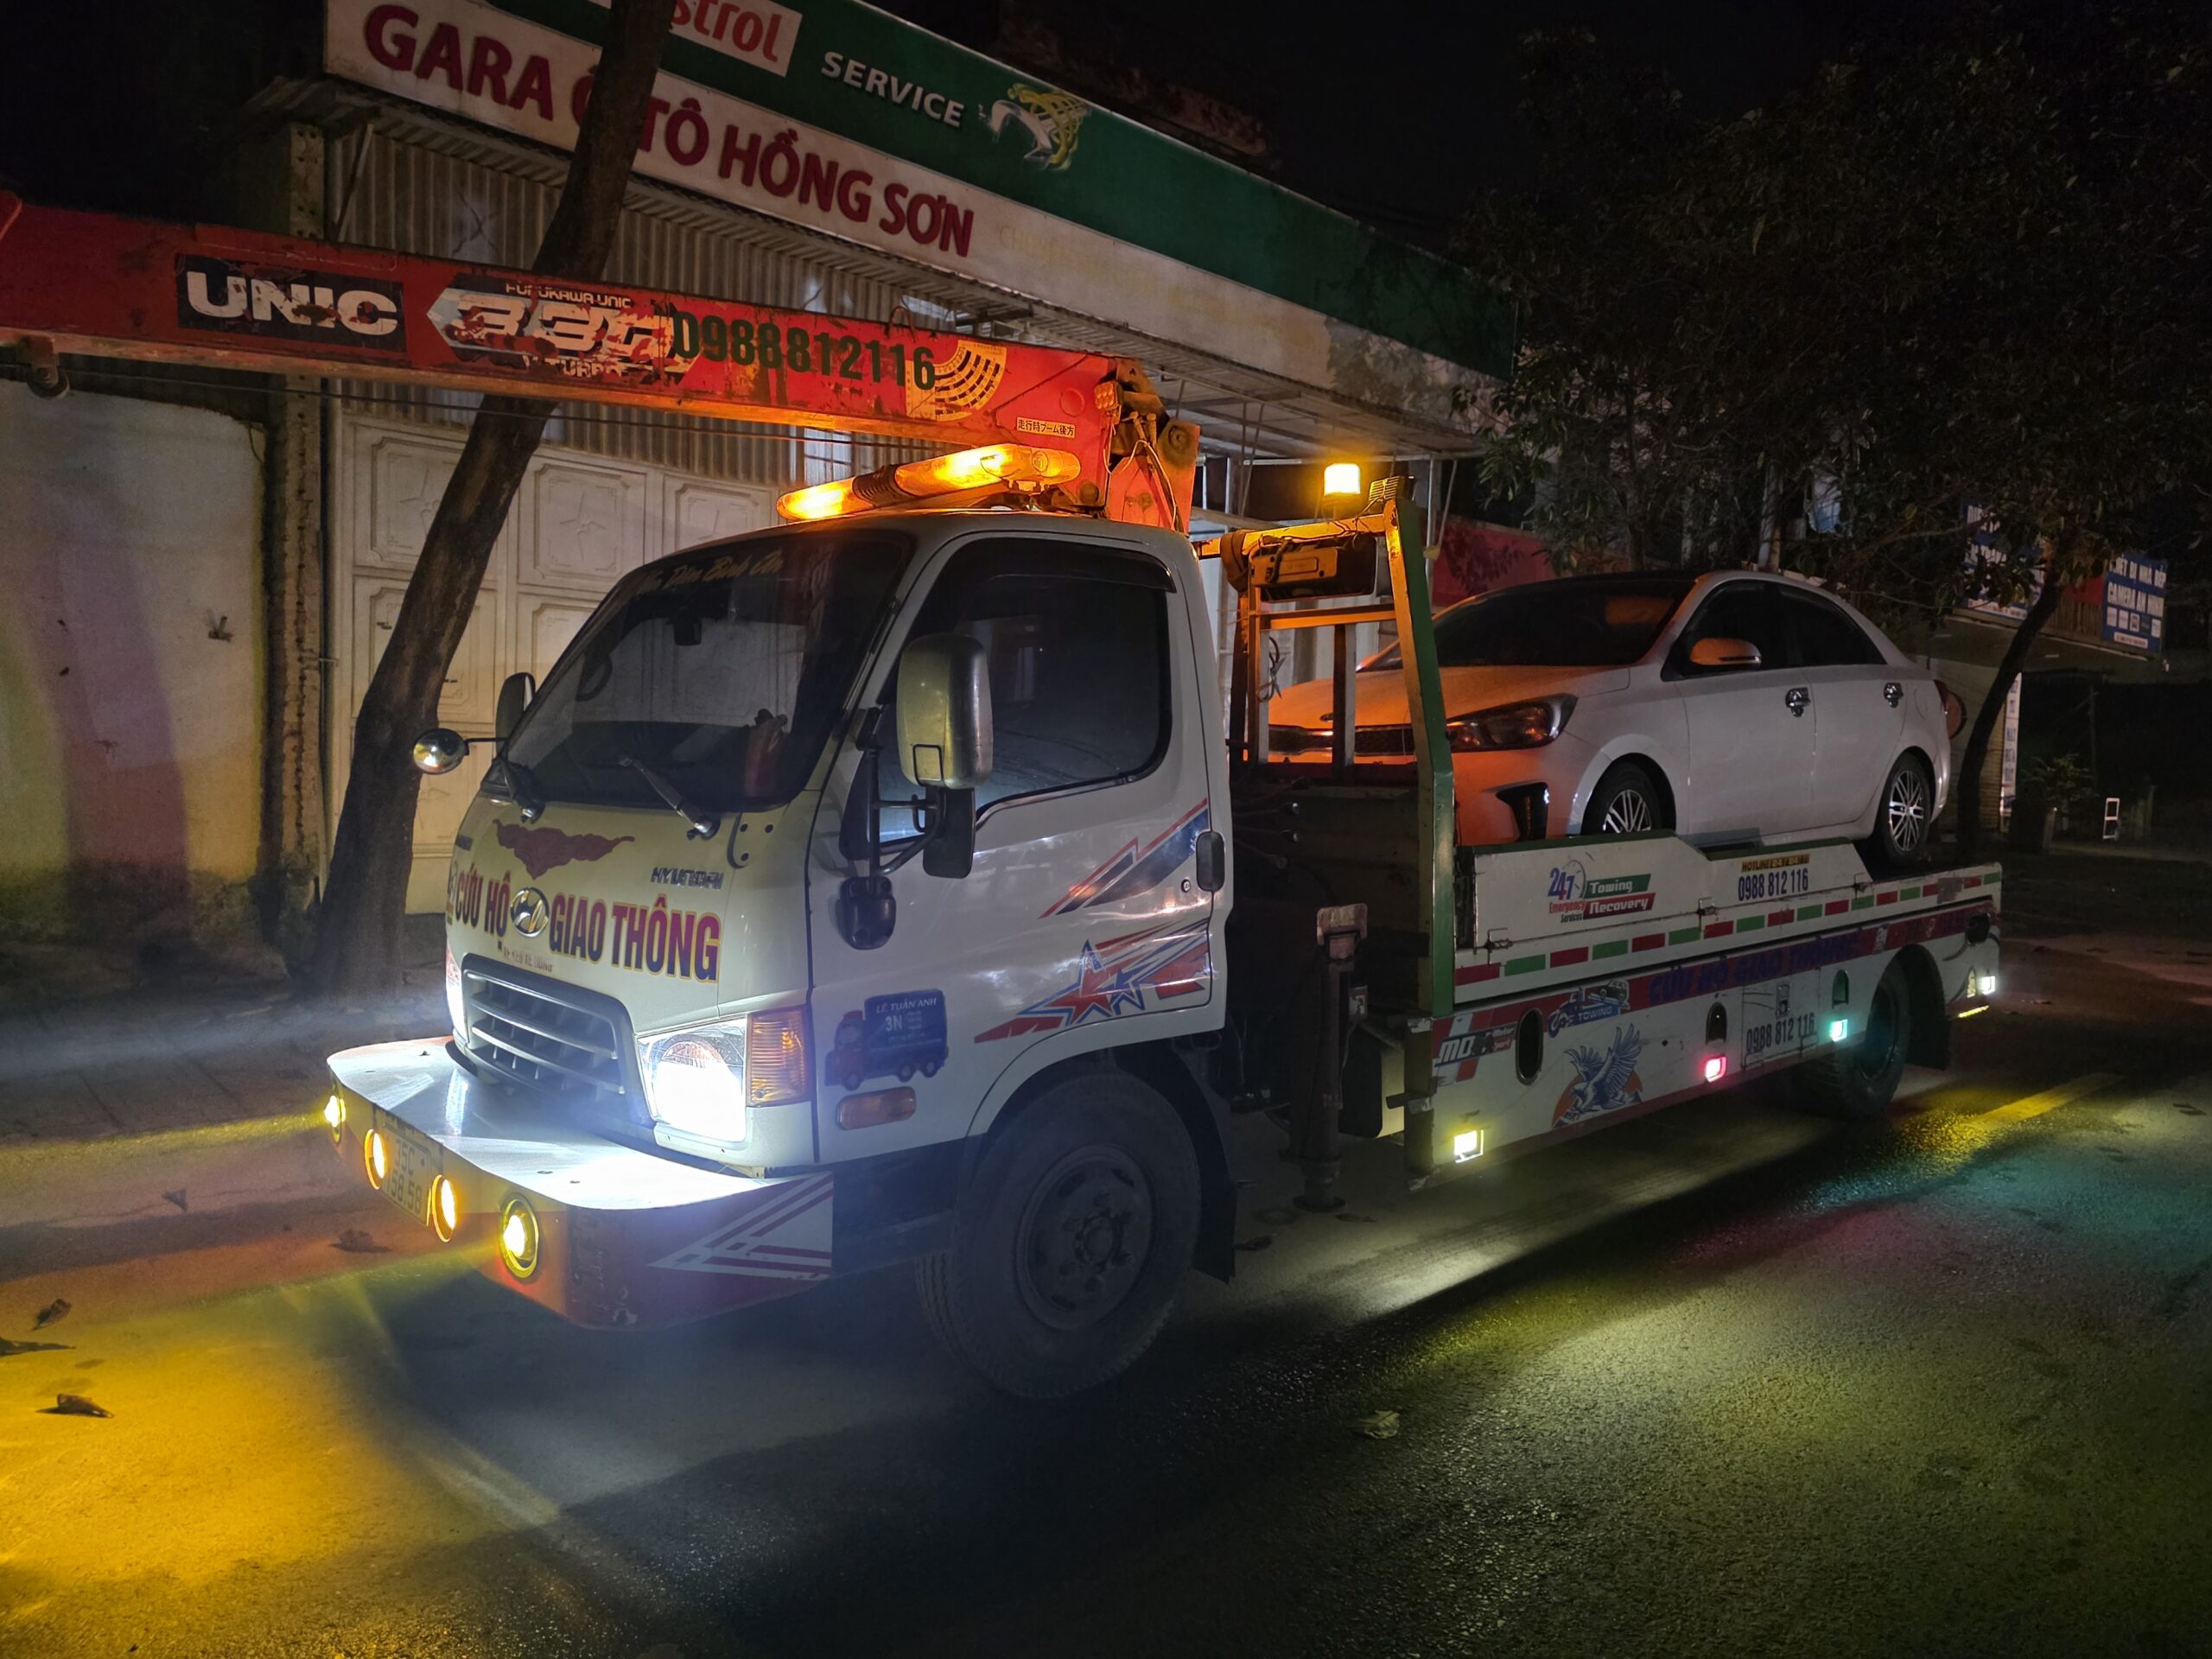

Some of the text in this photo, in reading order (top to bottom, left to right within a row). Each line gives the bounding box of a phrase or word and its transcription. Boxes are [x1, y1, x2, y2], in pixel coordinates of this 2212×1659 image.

[672, 0, 782, 62] strol
[821, 50, 965, 128] SERVICE
[365, 3, 554, 122] GARA
[639, 97, 710, 167] TÔ
[718, 124, 873, 223] HỒNG
[880, 182, 975, 257] SƠN
[186, 270, 398, 336] UNIC
[673, 310, 936, 391] 0988812116
[1017, 418, 1076, 438] 走行時ブーム後方
[651, 867, 724, 890] HYUNDAI
[1589, 880, 1633, 895] Towing
[1738, 868, 1808, 901] 0988 812 116
[1548, 900, 1586, 914] Emergency
[1560, 912, 1583, 923] Services
[1589, 898, 1649, 914] Recovery
[454, 862, 484, 928] CỨU
[484, 870, 511, 950] HỘ
[549, 892, 607, 965] GIAO
[610, 893, 721, 984] THÔNG
[918, 997, 938, 1007] ANH
[1577, 1006, 1613, 1021] TOWING
[885, 1014, 903, 1032] 3N
[1746, 1012, 1815, 1054] 0988 812 116
